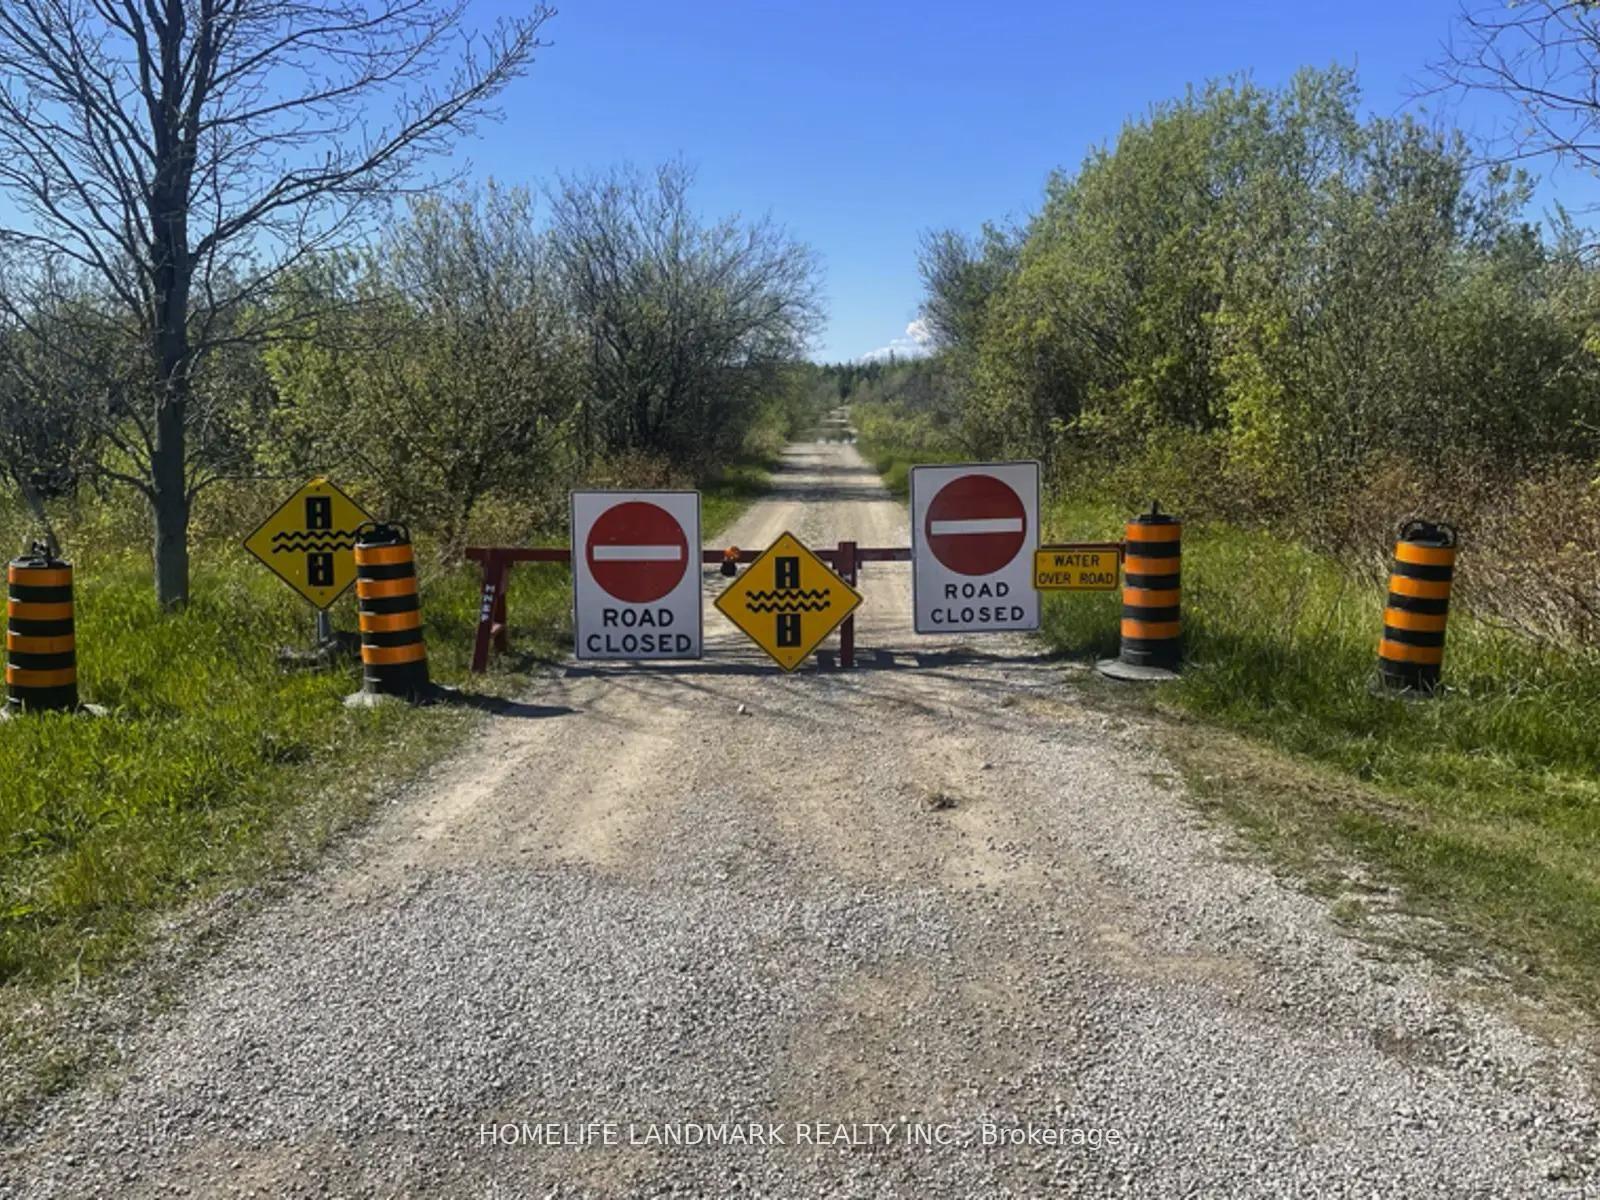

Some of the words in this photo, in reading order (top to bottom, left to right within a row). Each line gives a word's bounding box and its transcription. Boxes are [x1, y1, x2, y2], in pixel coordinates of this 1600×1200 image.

[1055, 554, 1100, 567] WATER
[1038, 573, 1071, 584] OVER
[1079, 572, 1114, 584] ROAD
[945, 582, 1010, 599] ROAD
[603, 608, 674, 627] ROAD
[931, 606, 1025, 624] CLOSED
[587, 634, 692, 653] CLOSED
